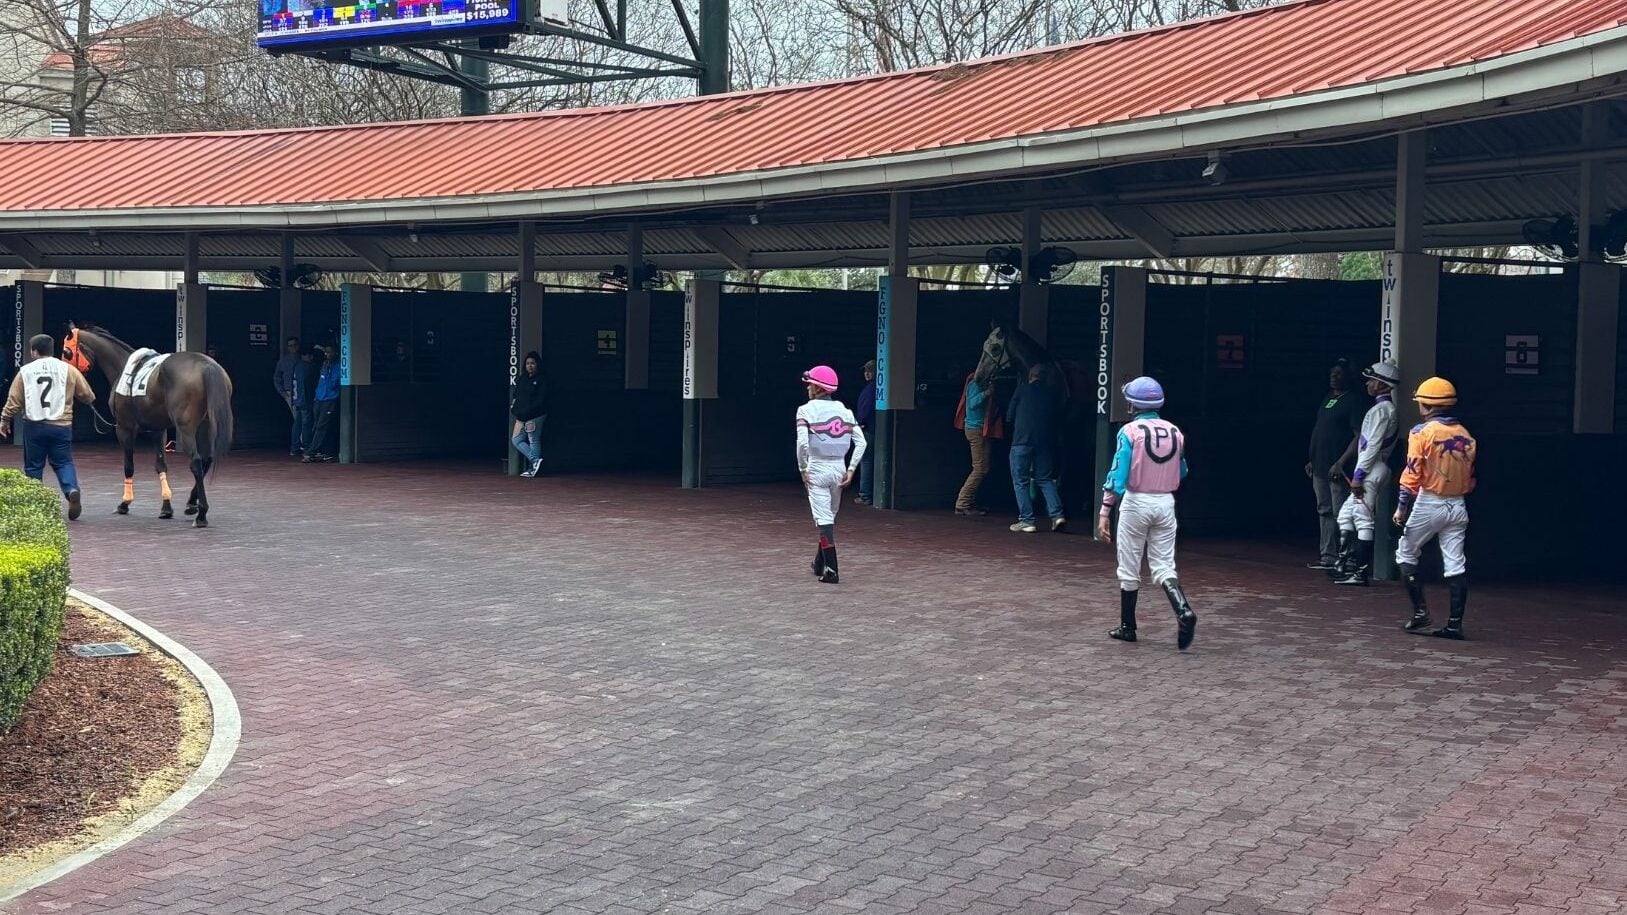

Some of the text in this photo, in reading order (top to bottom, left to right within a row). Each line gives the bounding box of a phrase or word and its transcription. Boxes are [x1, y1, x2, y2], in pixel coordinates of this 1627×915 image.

[466, 8, 509, 21] $15,989
[14, 284, 23, 368] SPORTSBOOK
[509, 286, 518, 386] SPORTSBOOK
[684, 282, 693, 396] twinspires
[1097, 274, 1110, 414] SPORTSBOOK
[37, 376, 53, 408] 2
